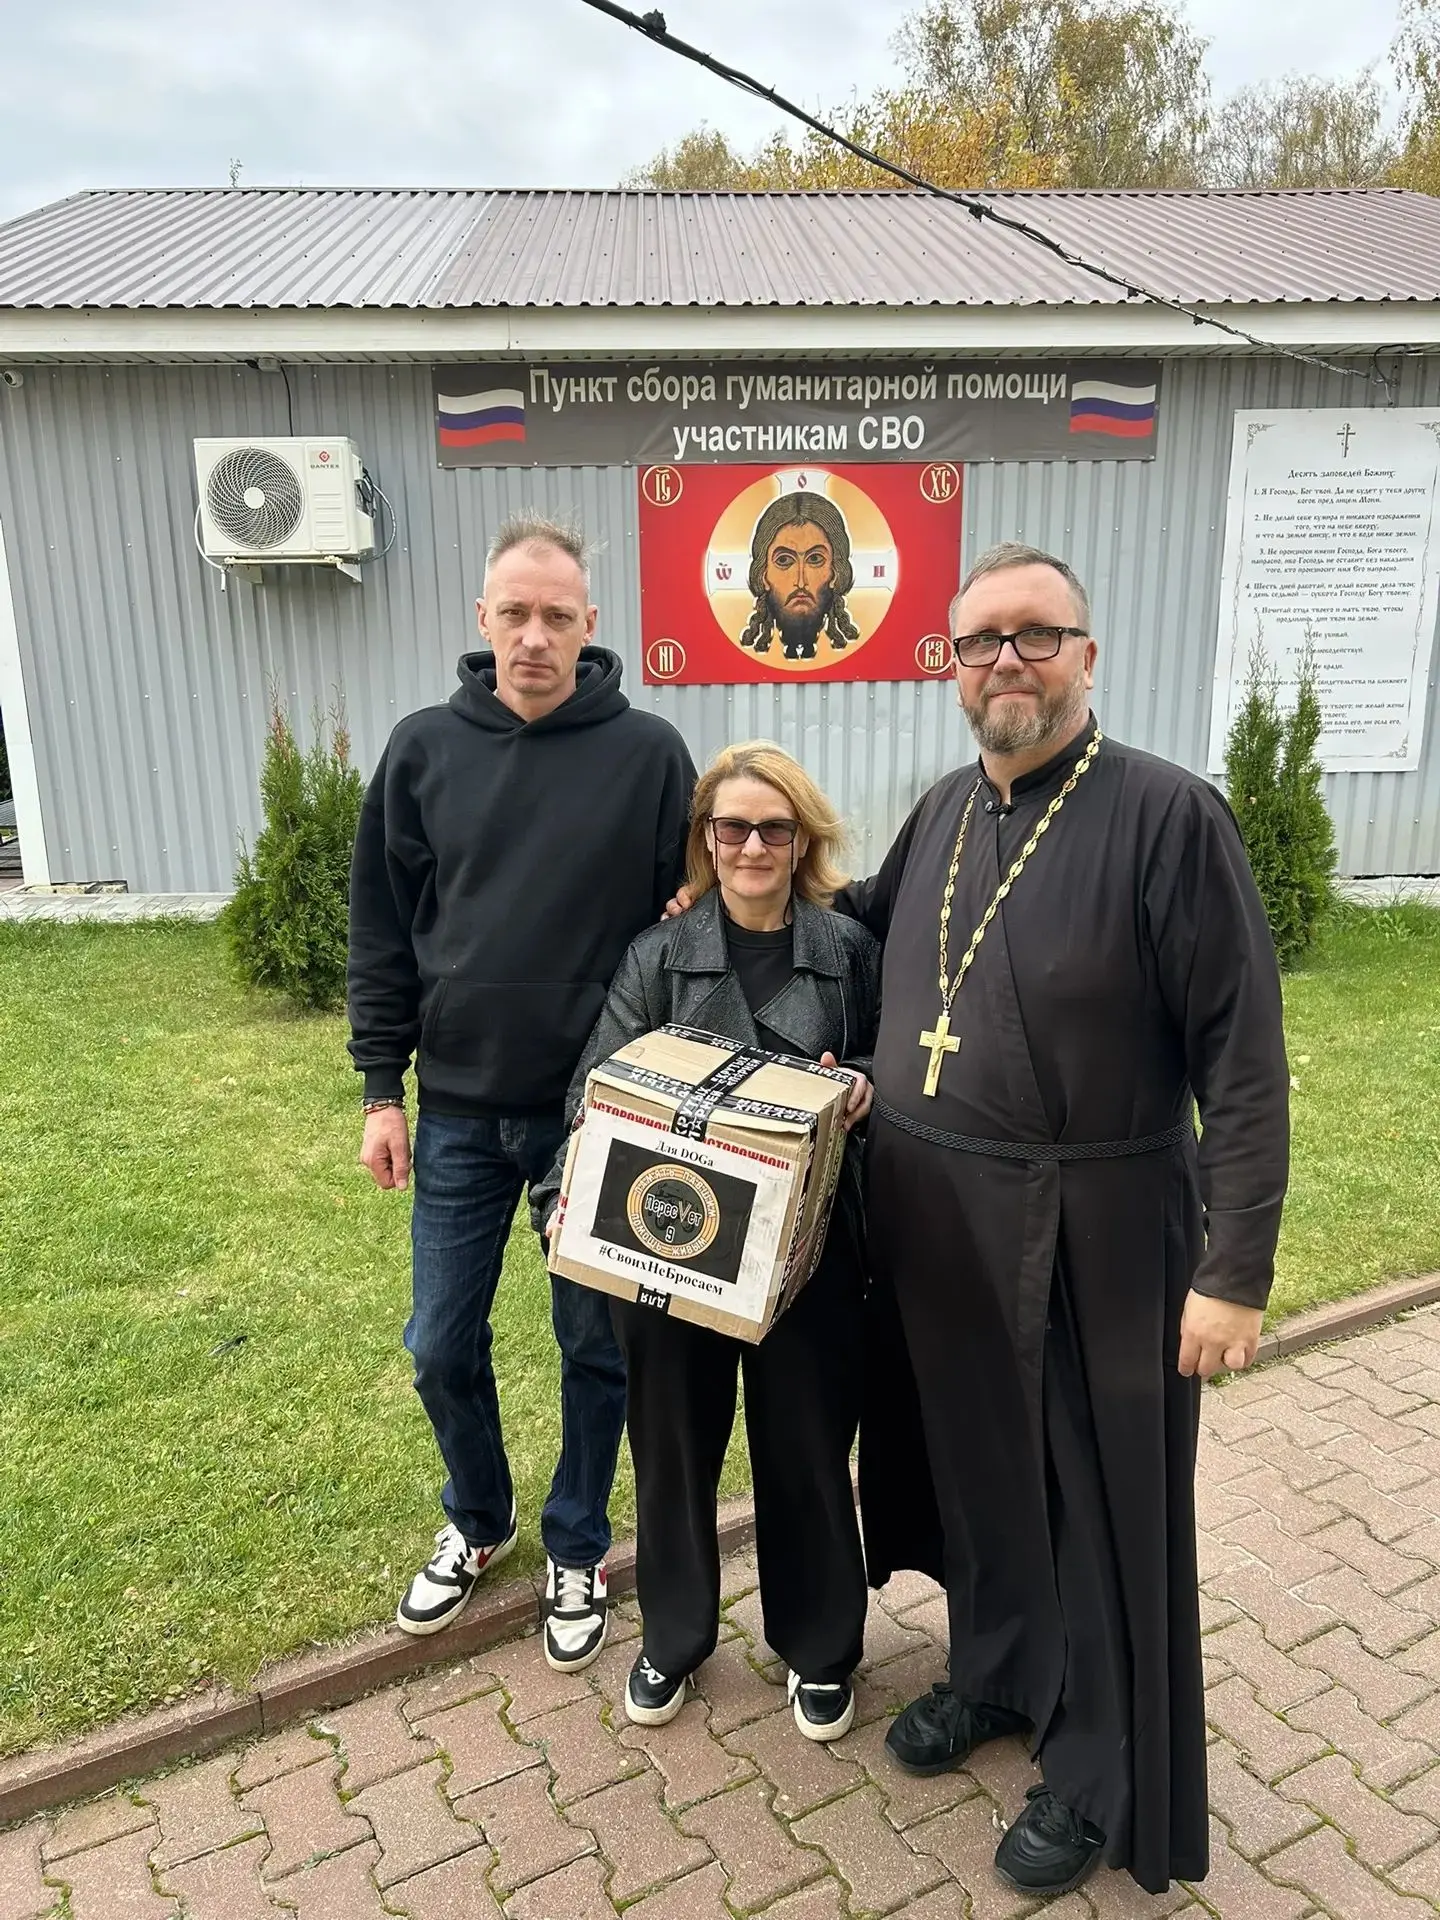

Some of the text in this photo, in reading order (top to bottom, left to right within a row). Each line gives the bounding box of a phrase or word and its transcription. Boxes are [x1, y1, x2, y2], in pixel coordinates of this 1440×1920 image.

[530, 365, 1067, 412] Пункт сбора гуманитарной помощи
[673, 415, 925, 460] участникам СВО
[1288, 469, 1318, 479] Десять
[1320, 470, 1362, 478] заповедей
[1300, 487, 1313, 495] Бог
[1334, 486, 1344, 495] Да
[1403, 487, 1426, 495] других
[1367, 546, 1382, 554] Бога
[1254, 582, 1277, 590] Шесть
[655, 1140, 679, 1157] Для
[598, 1244, 724, 1297] #СвоихНеБросаем
